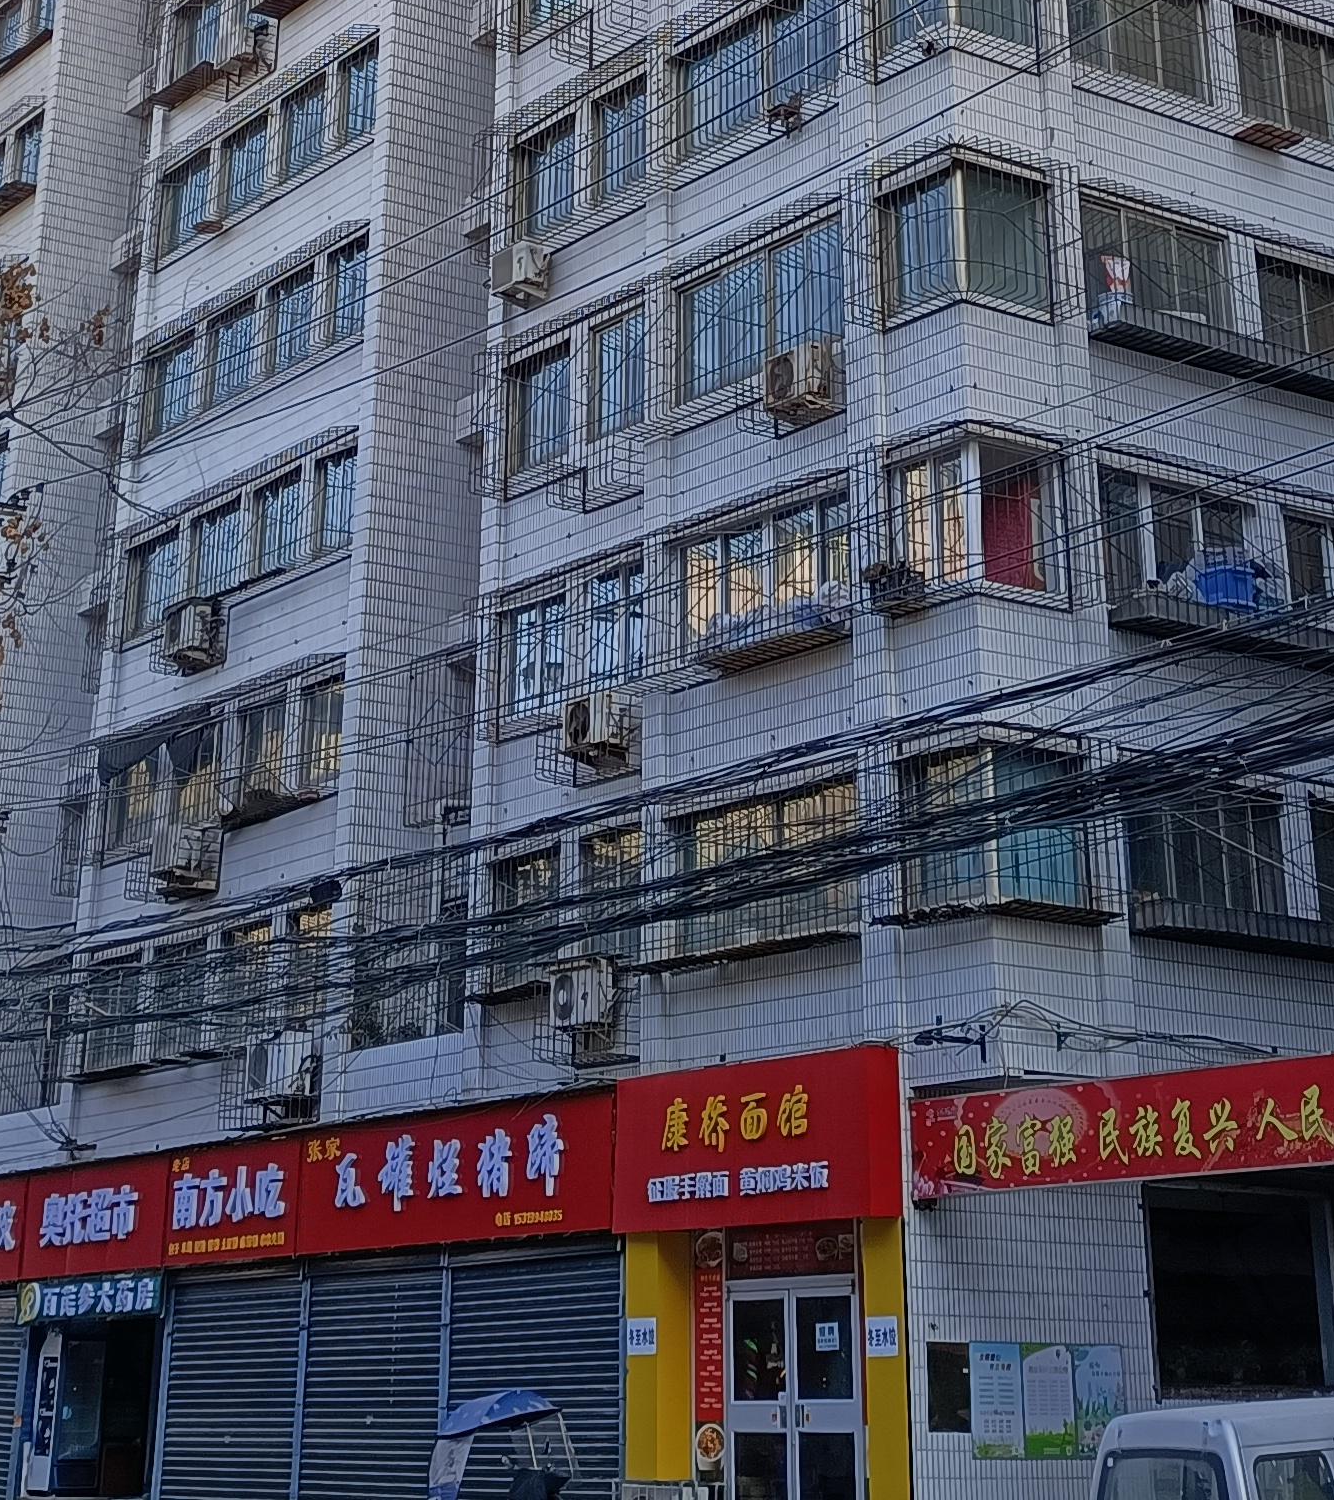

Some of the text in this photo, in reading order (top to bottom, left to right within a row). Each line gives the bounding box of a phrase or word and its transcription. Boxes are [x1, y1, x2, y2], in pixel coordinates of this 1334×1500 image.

[661, 1084, 809, 1153] 康桥面馆
[953, 1111, 1078, 1180] 国家富强
[1098, 1097, 1240, 1166] 民族复兴
[171, 1162, 286, 1230] 南方小吃
[739, 1160, 829, 1197] 黄焖鸡米饭
